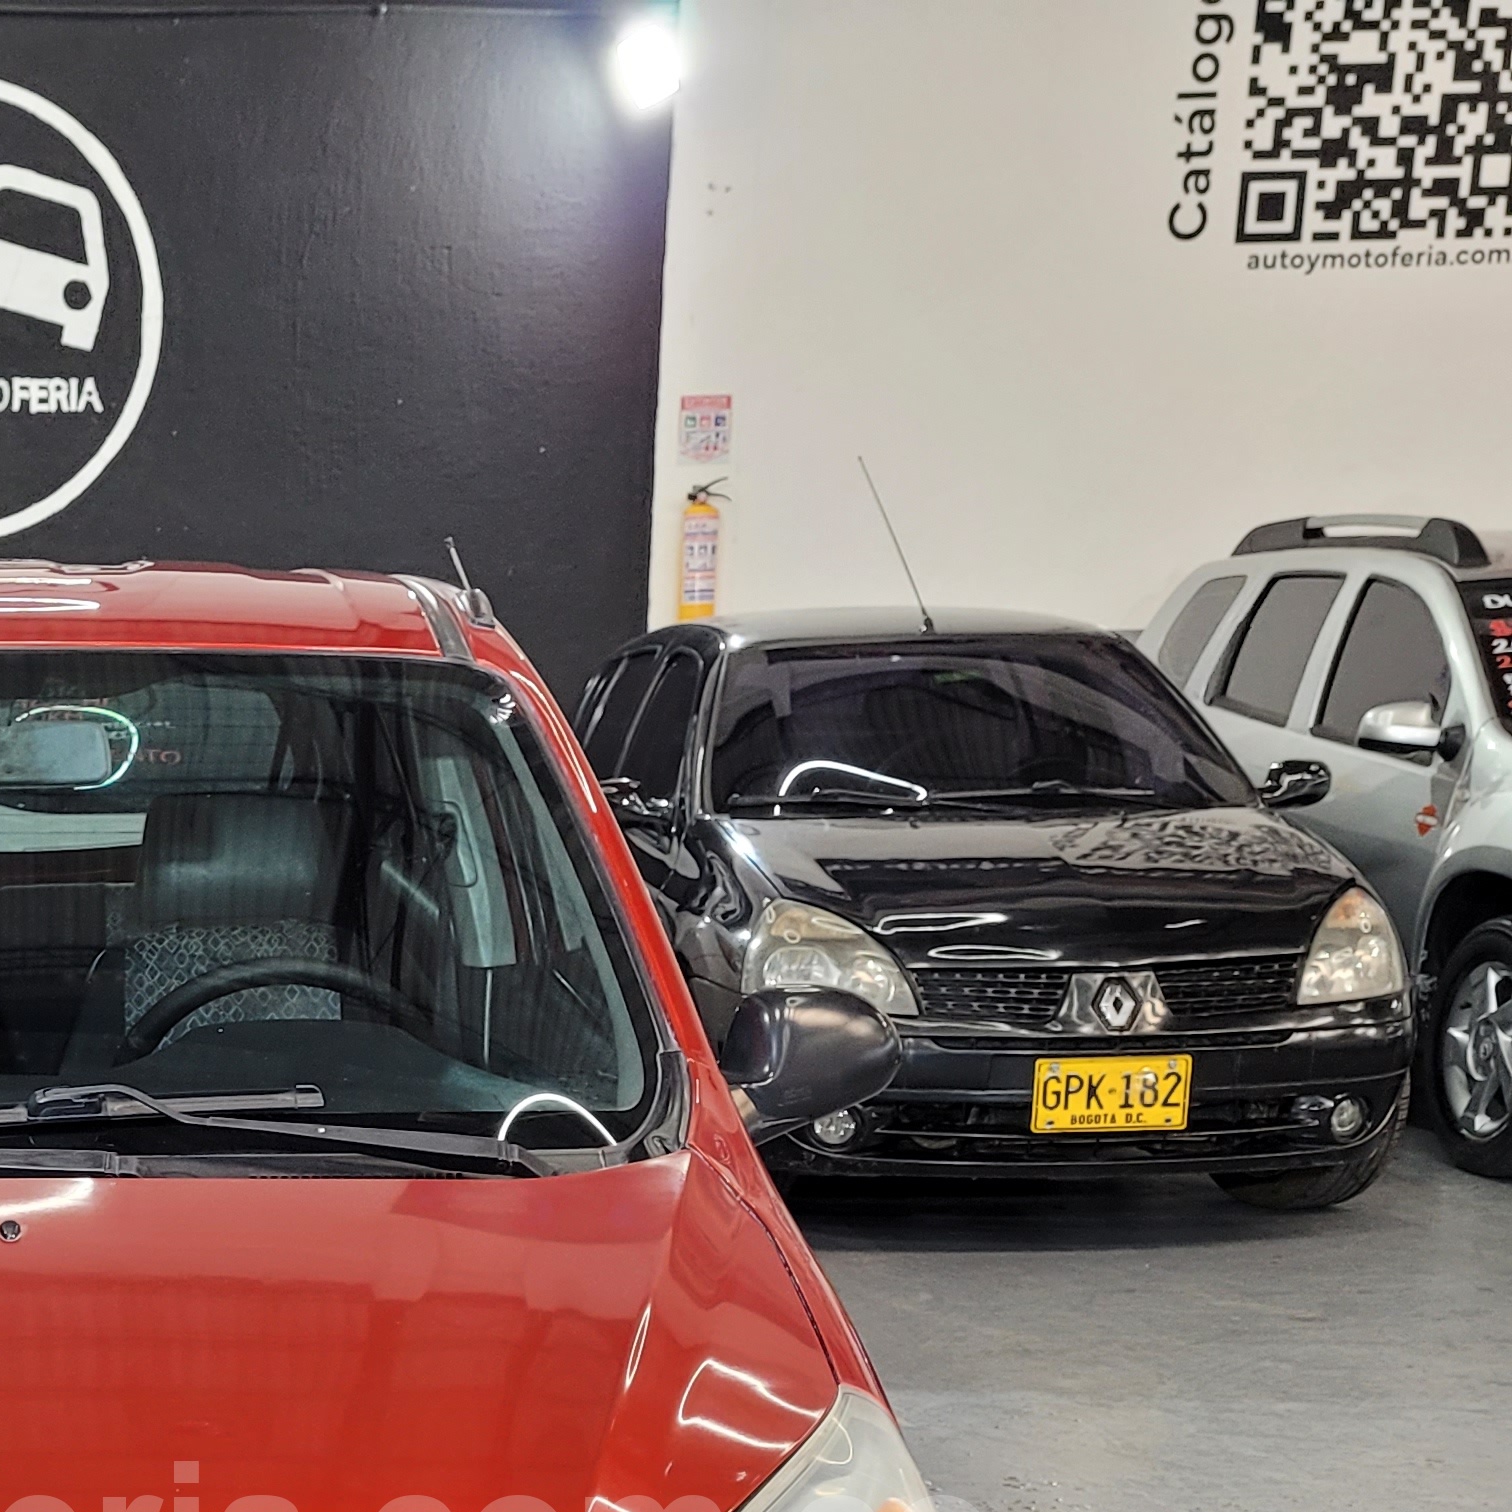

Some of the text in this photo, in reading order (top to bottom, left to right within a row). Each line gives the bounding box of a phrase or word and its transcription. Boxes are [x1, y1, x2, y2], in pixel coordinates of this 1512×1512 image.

[1169, 0, 1234, 240] Catálog
[1247, 247, 1512, 275] autoymotoferia.com
[1070, 1113, 1117, 1125] BOGOTA
